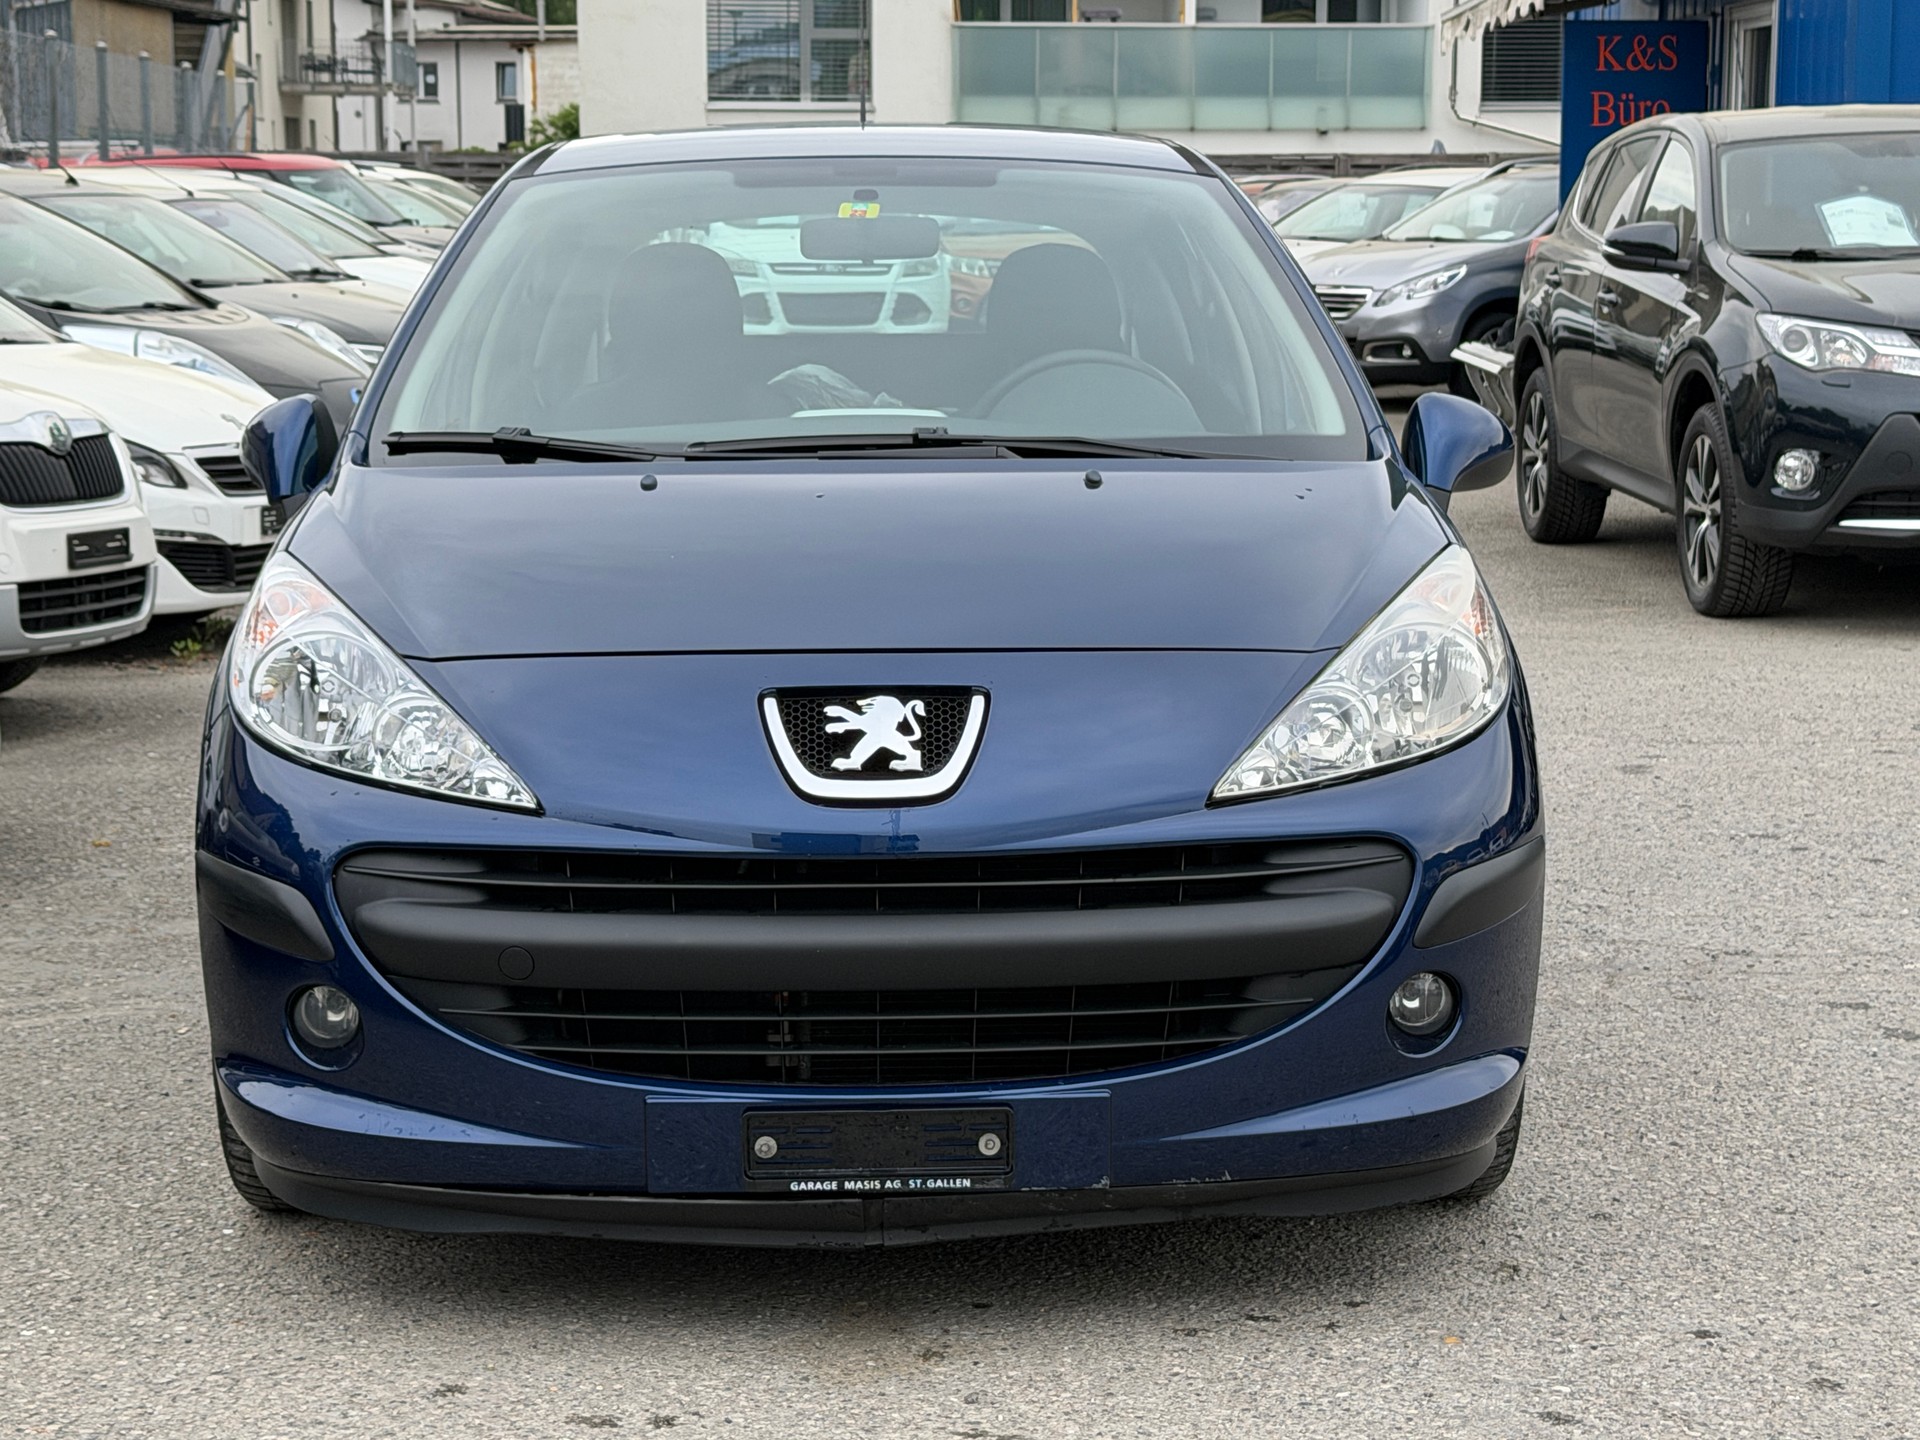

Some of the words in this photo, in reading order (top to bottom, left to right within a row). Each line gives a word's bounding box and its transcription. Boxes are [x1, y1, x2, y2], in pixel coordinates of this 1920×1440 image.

[1595, 34, 1678, 72] K&S
[790, 1181, 838, 1191] GARAGE
[844, 1180, 881, 1190] MASIS
[884, 1179, 901, 1189] AG
